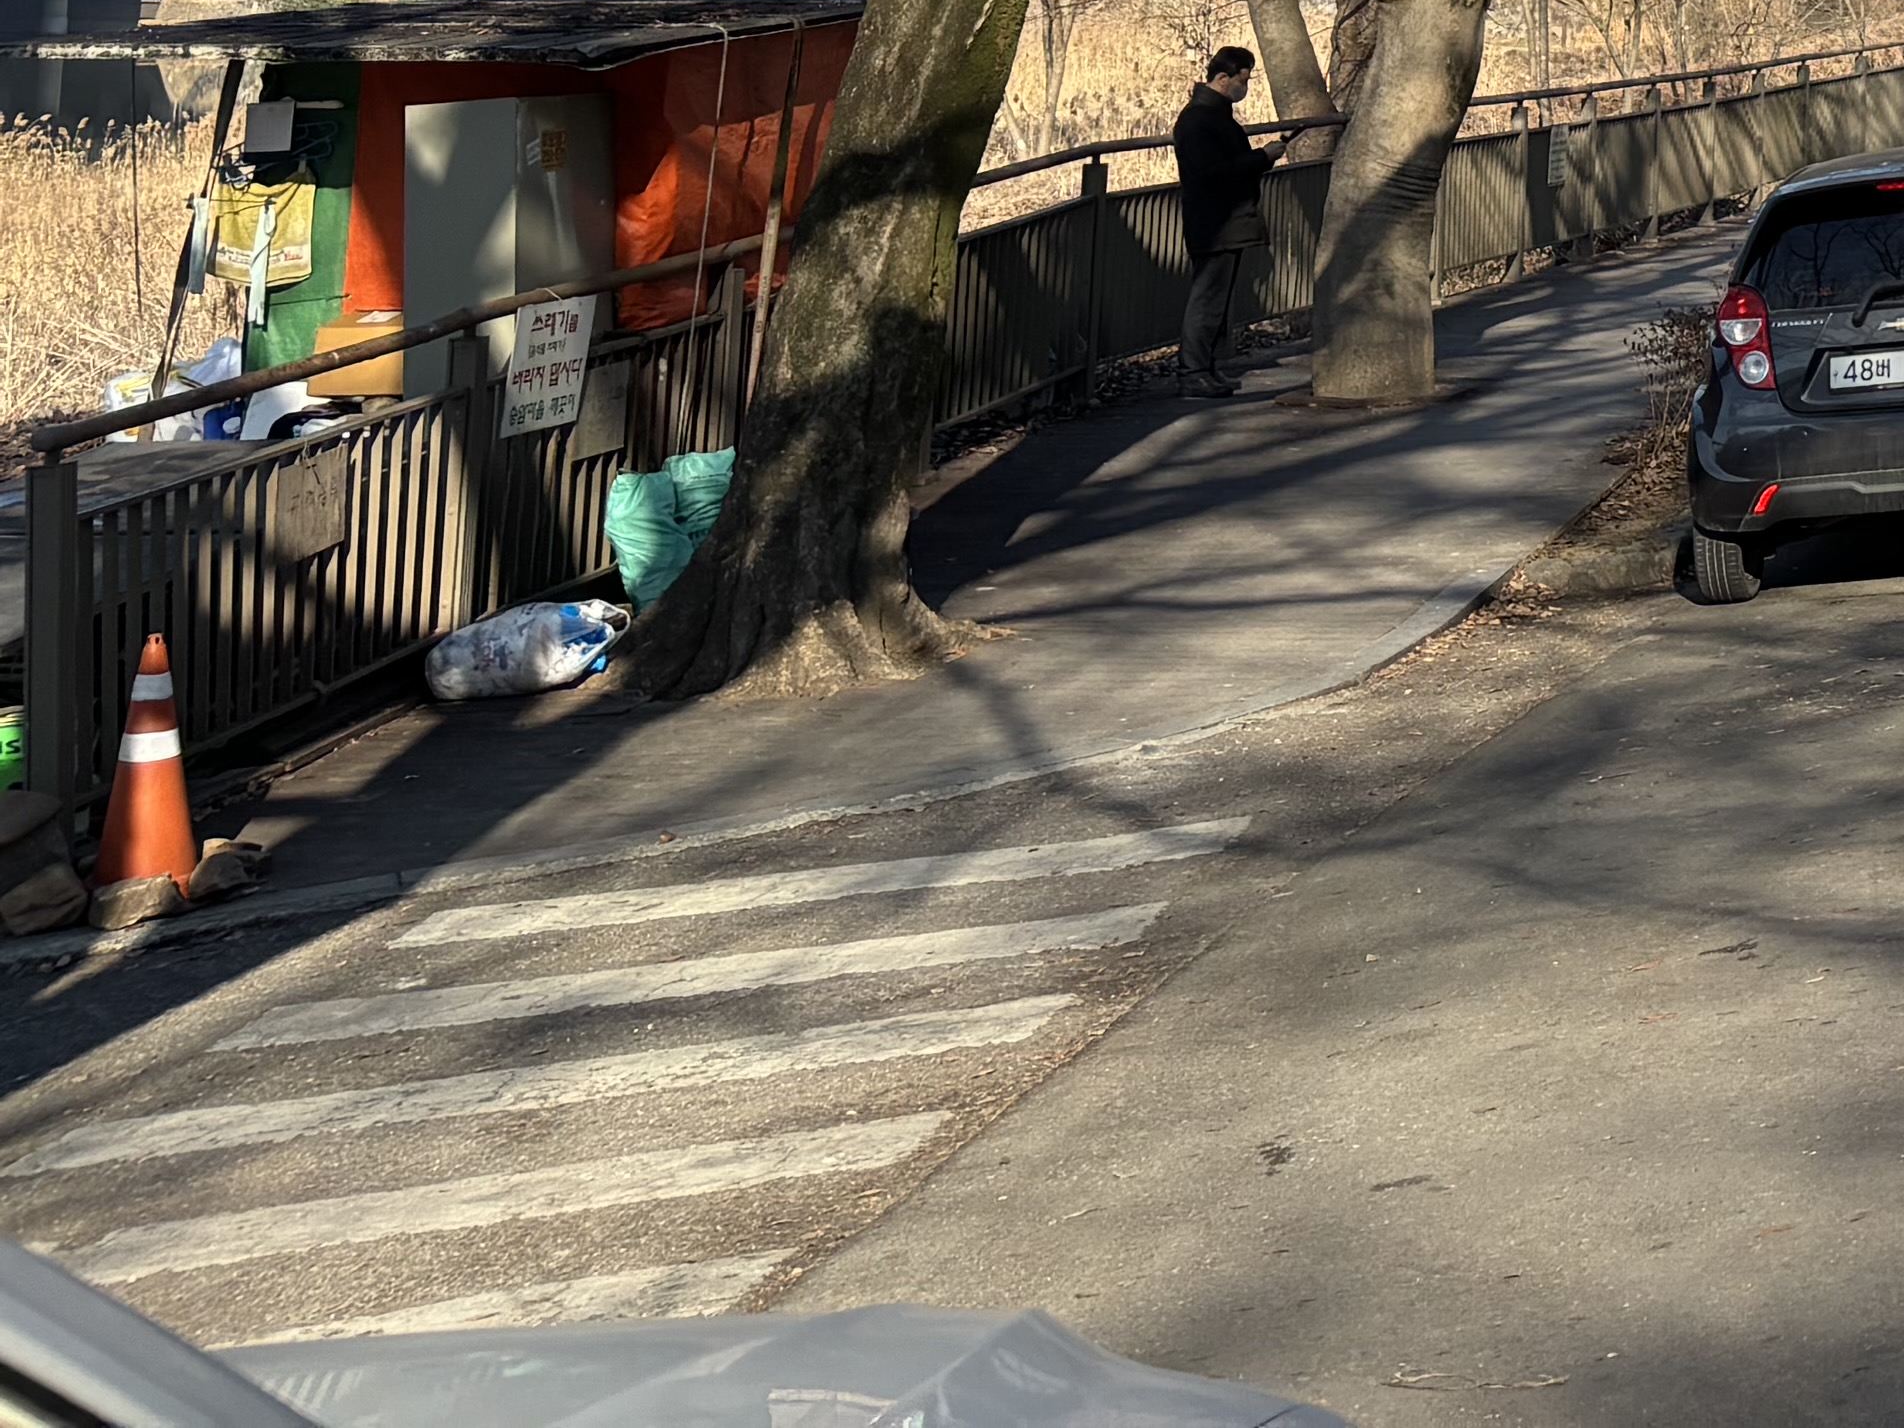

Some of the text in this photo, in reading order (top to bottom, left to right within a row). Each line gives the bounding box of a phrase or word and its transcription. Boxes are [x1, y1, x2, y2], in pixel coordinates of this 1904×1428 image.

[530, 309, 579, 336] 쓰레기를
[511, 365, 546, 394] 버리지
[1843, 357, 1891, 383] 48버
